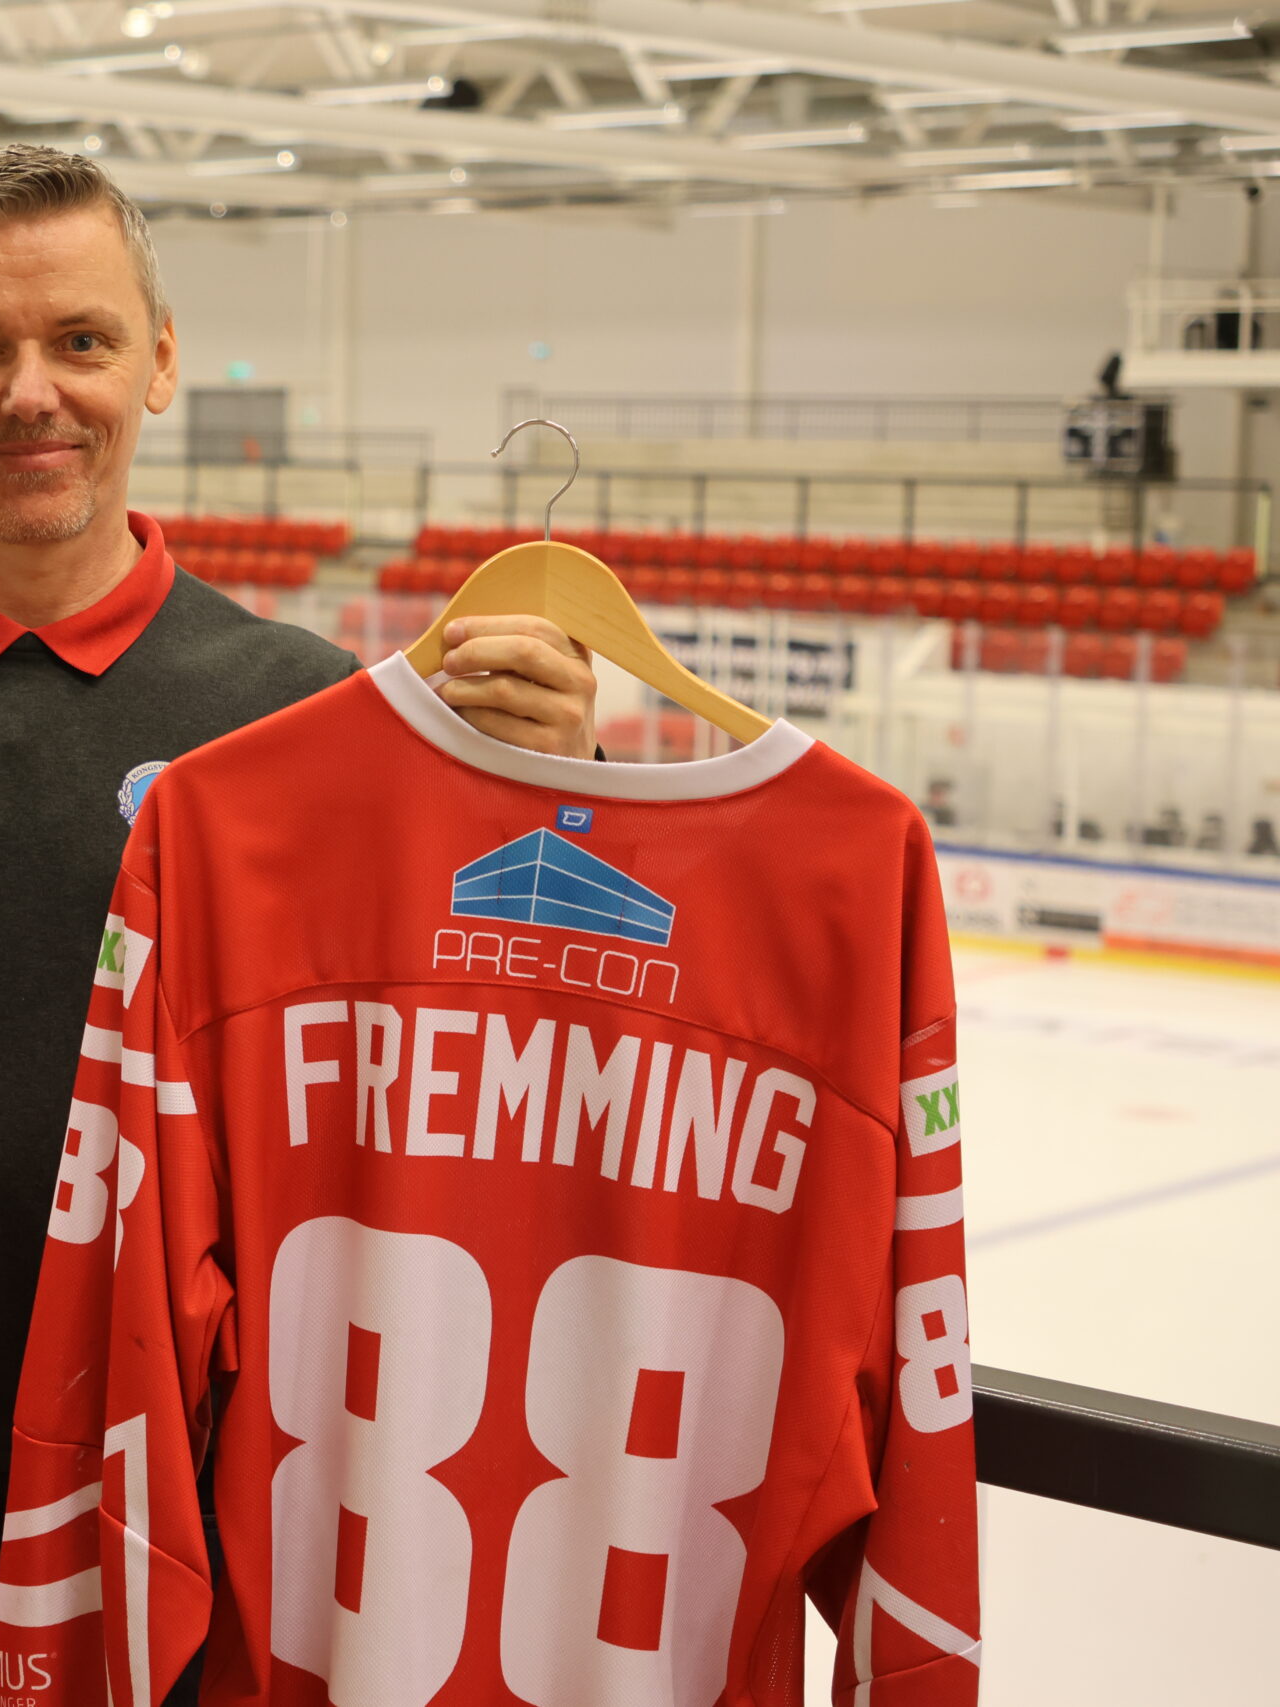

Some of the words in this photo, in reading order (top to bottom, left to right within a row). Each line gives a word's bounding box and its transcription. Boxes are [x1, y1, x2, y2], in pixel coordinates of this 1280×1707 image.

[433, 929, 680, 1003] PRE-CON
[284, 1000, 817, 1214] FREMMING
[915, 1081, 960, 1136] XX
[268, 1215, 785, 1707] 88
